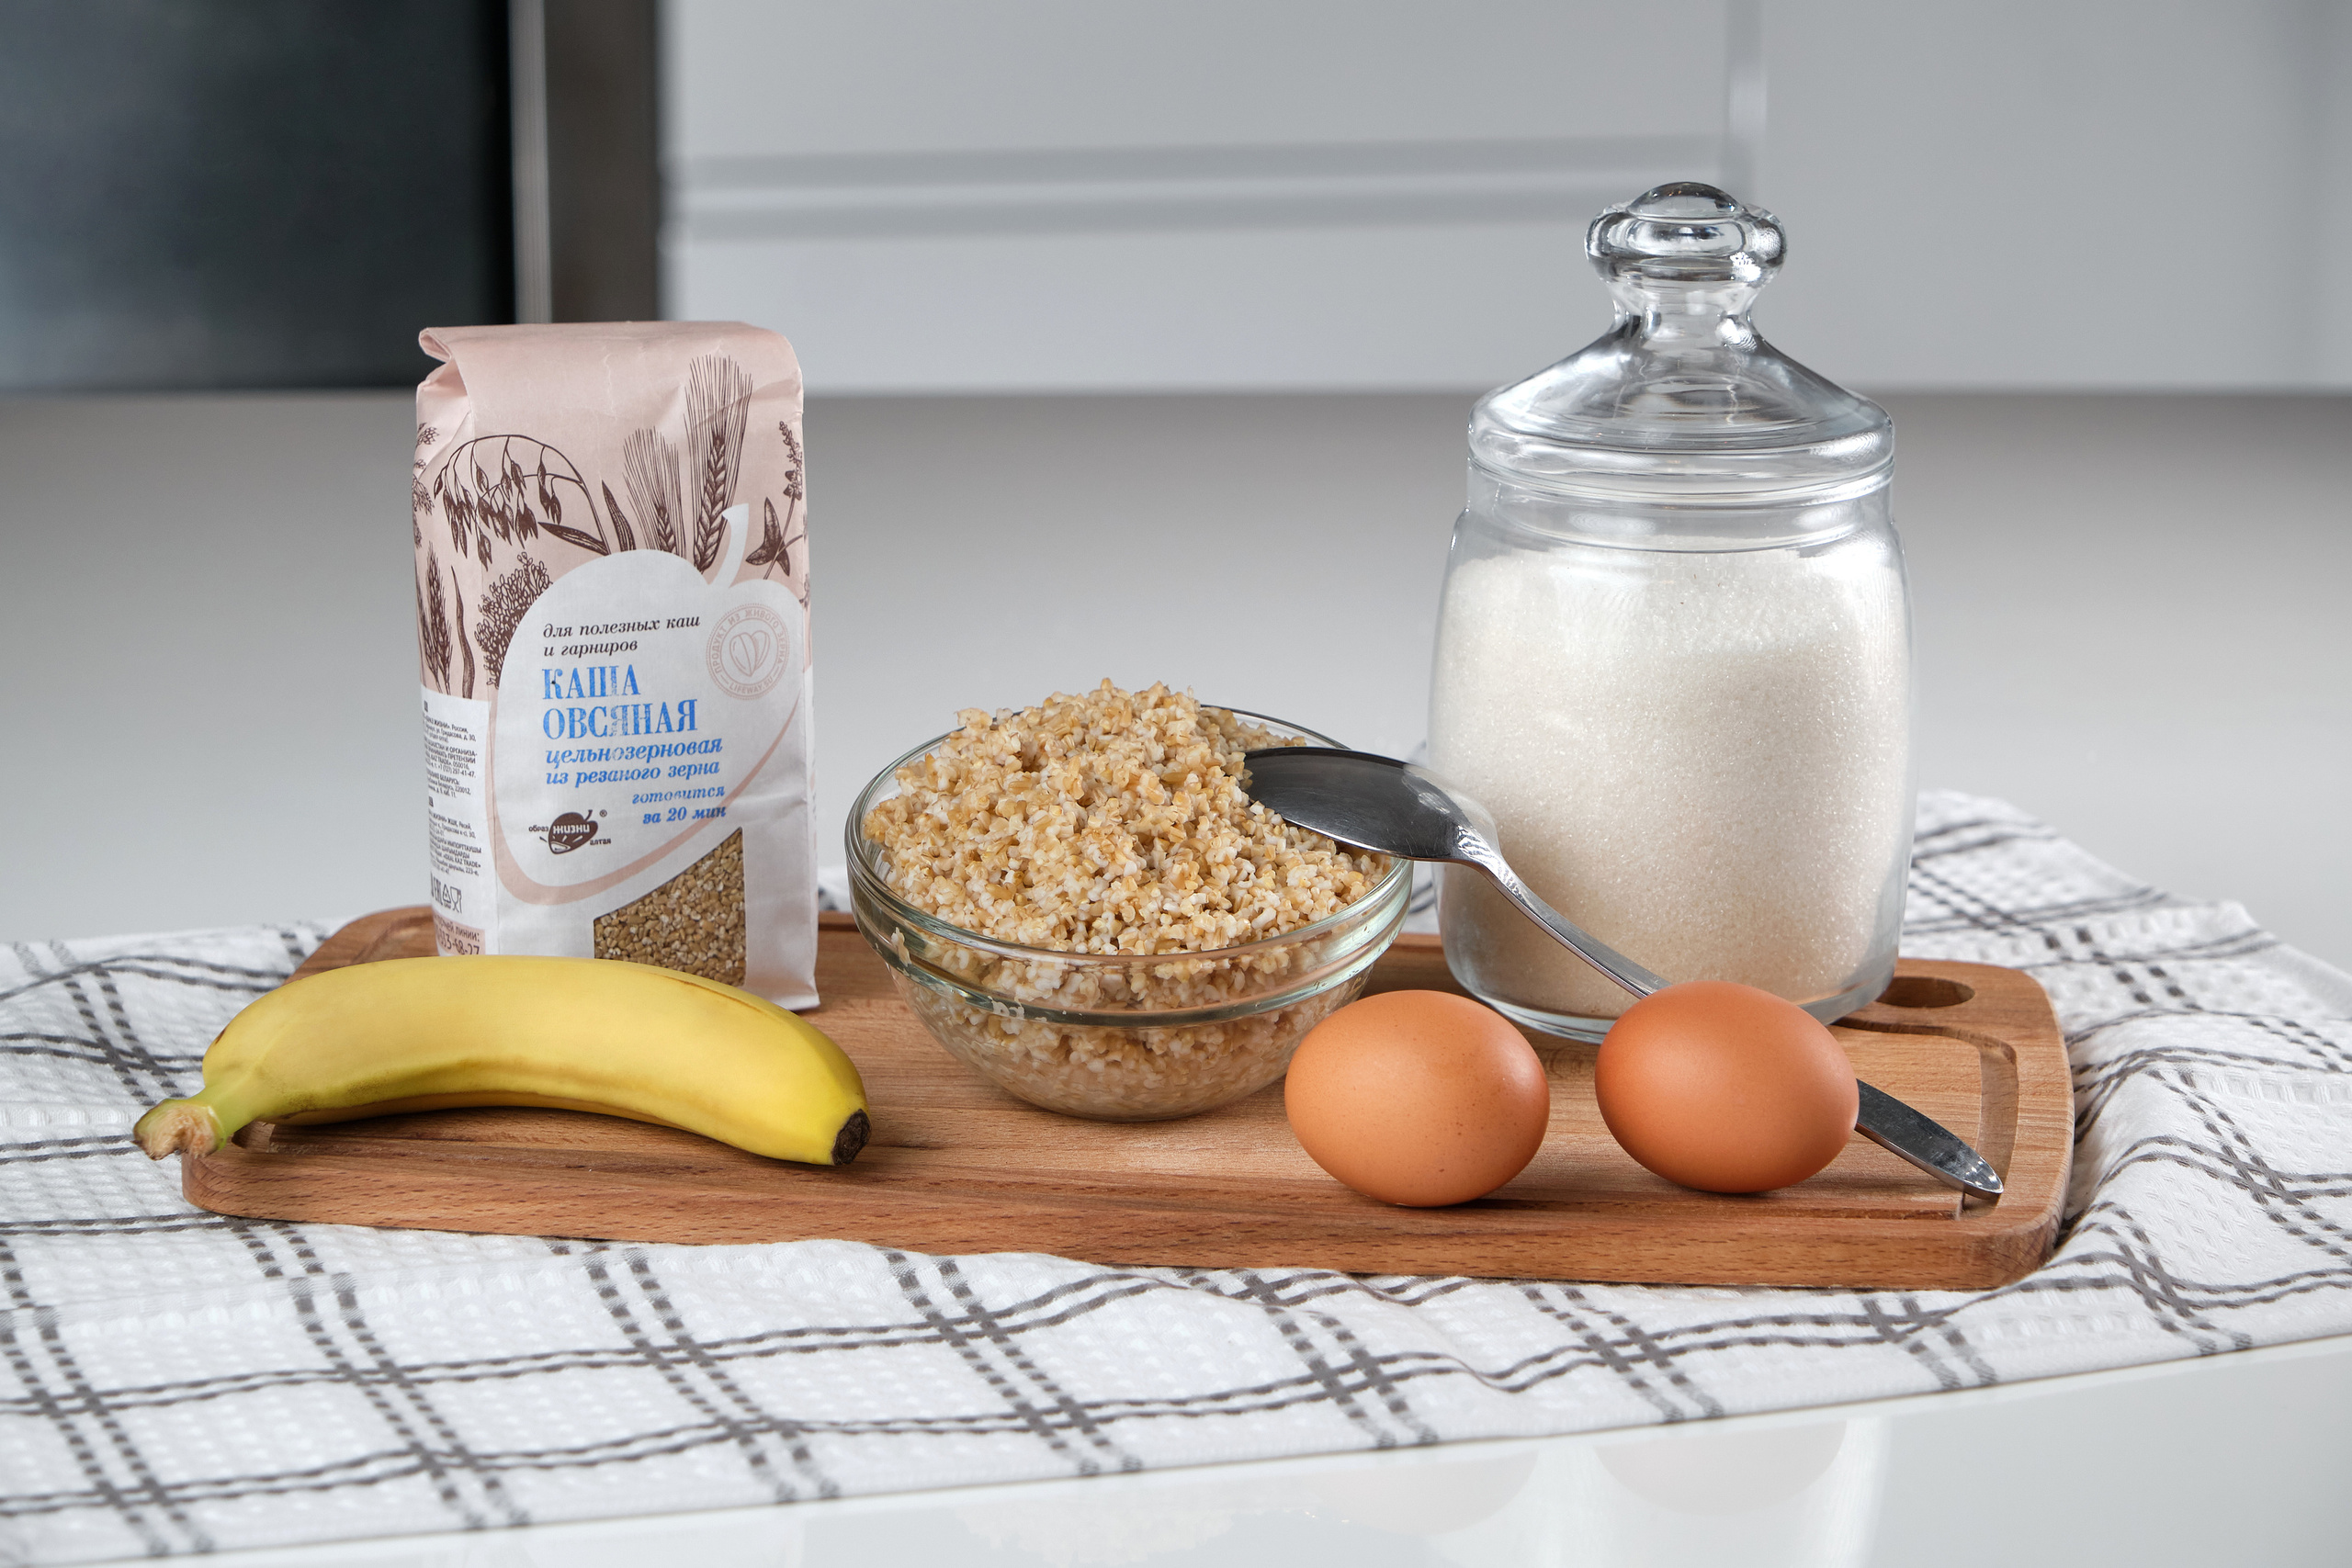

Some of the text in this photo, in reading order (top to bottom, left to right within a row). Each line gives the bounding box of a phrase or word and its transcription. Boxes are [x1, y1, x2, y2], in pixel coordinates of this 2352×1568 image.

[543, 615, 701, 638] для полезных каш
[543, 640, 639, 659] и гарниров
[712, 626, 727, 673] ПРОДУКТ
[728, 614, 741, 626] ИЗ
[745, 609, 779, 628] ЖИВОГО
[541, 663, 641, 700] КАША
[729, 676, 774, 694] LIFEWAY.SU
[542, 698, 698, 740] ОВСЯНАЯ
[545, 738, 723, 769] цельнозерновая
[546, 761, 720, 788] из резаного зерна
[632, 785, 726, 805] готовится
[642, 806, 727, 825] за 20 мин
[528, 825, 549, 833] образ
[589, 838, 612, 846] алтая
